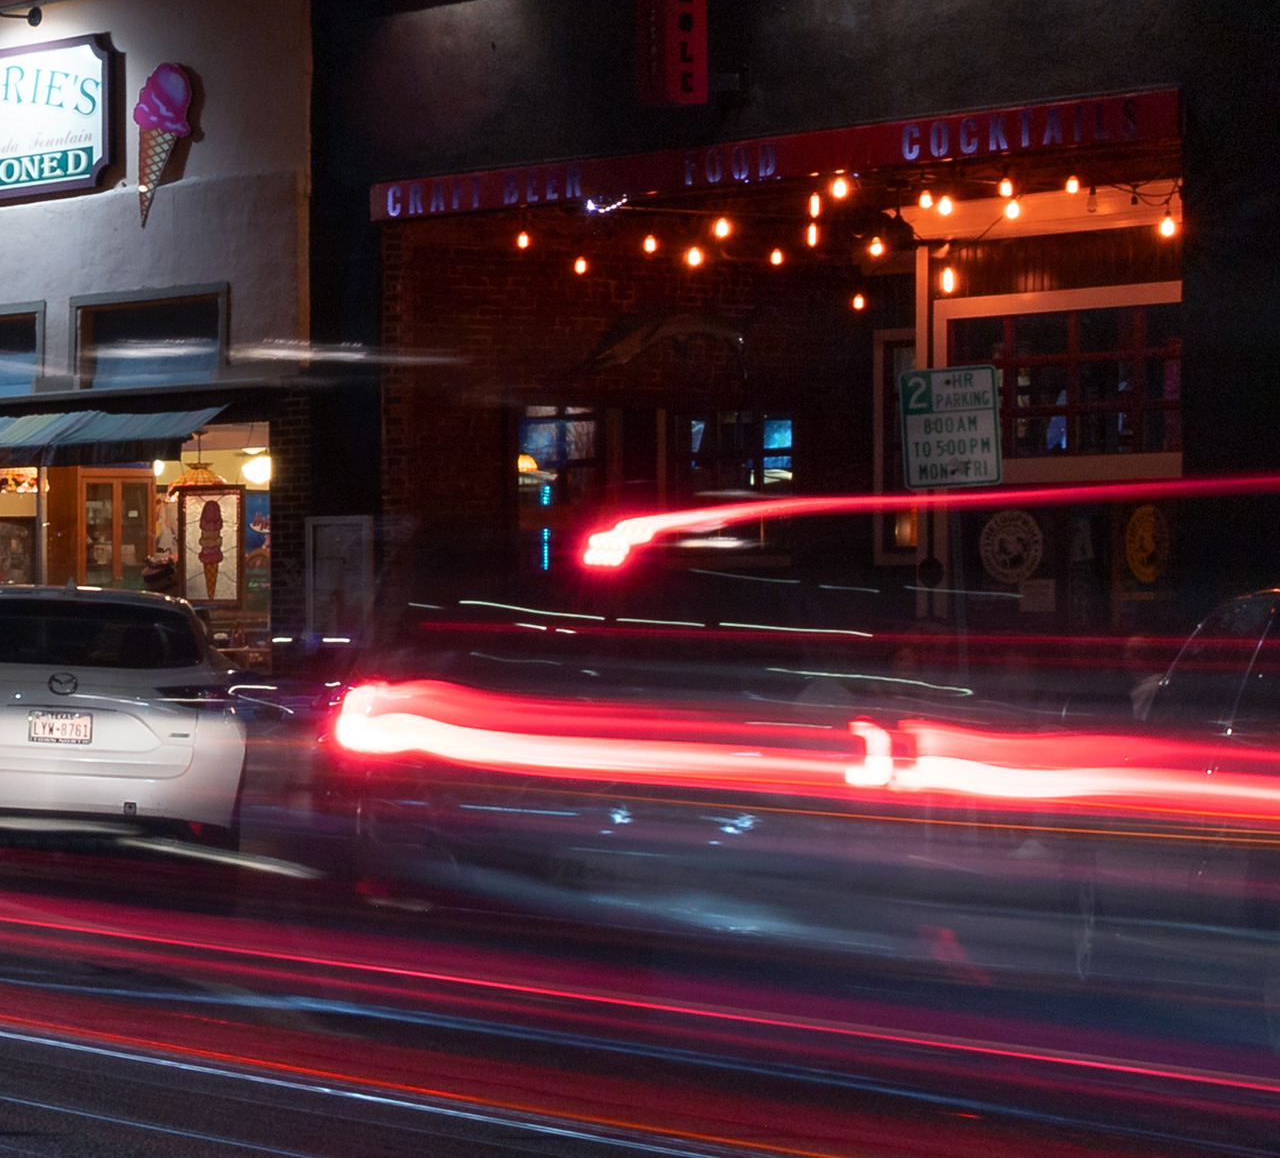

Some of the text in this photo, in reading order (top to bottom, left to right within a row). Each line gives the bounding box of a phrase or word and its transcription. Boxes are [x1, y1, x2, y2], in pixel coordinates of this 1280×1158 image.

[28, 129, 93, 150] Fountain
[901, 97, 1141, 161] COCKTAILS
[684, 143, 778, 186] FOOD
[386, 166, 582, 217] CRAFT BEER
[907, 377, 928, 409] 2
[952, 373, 974, 388] HR
[936, 391, 990, 409] PARKING
[913, 441, 932, 457] TO
